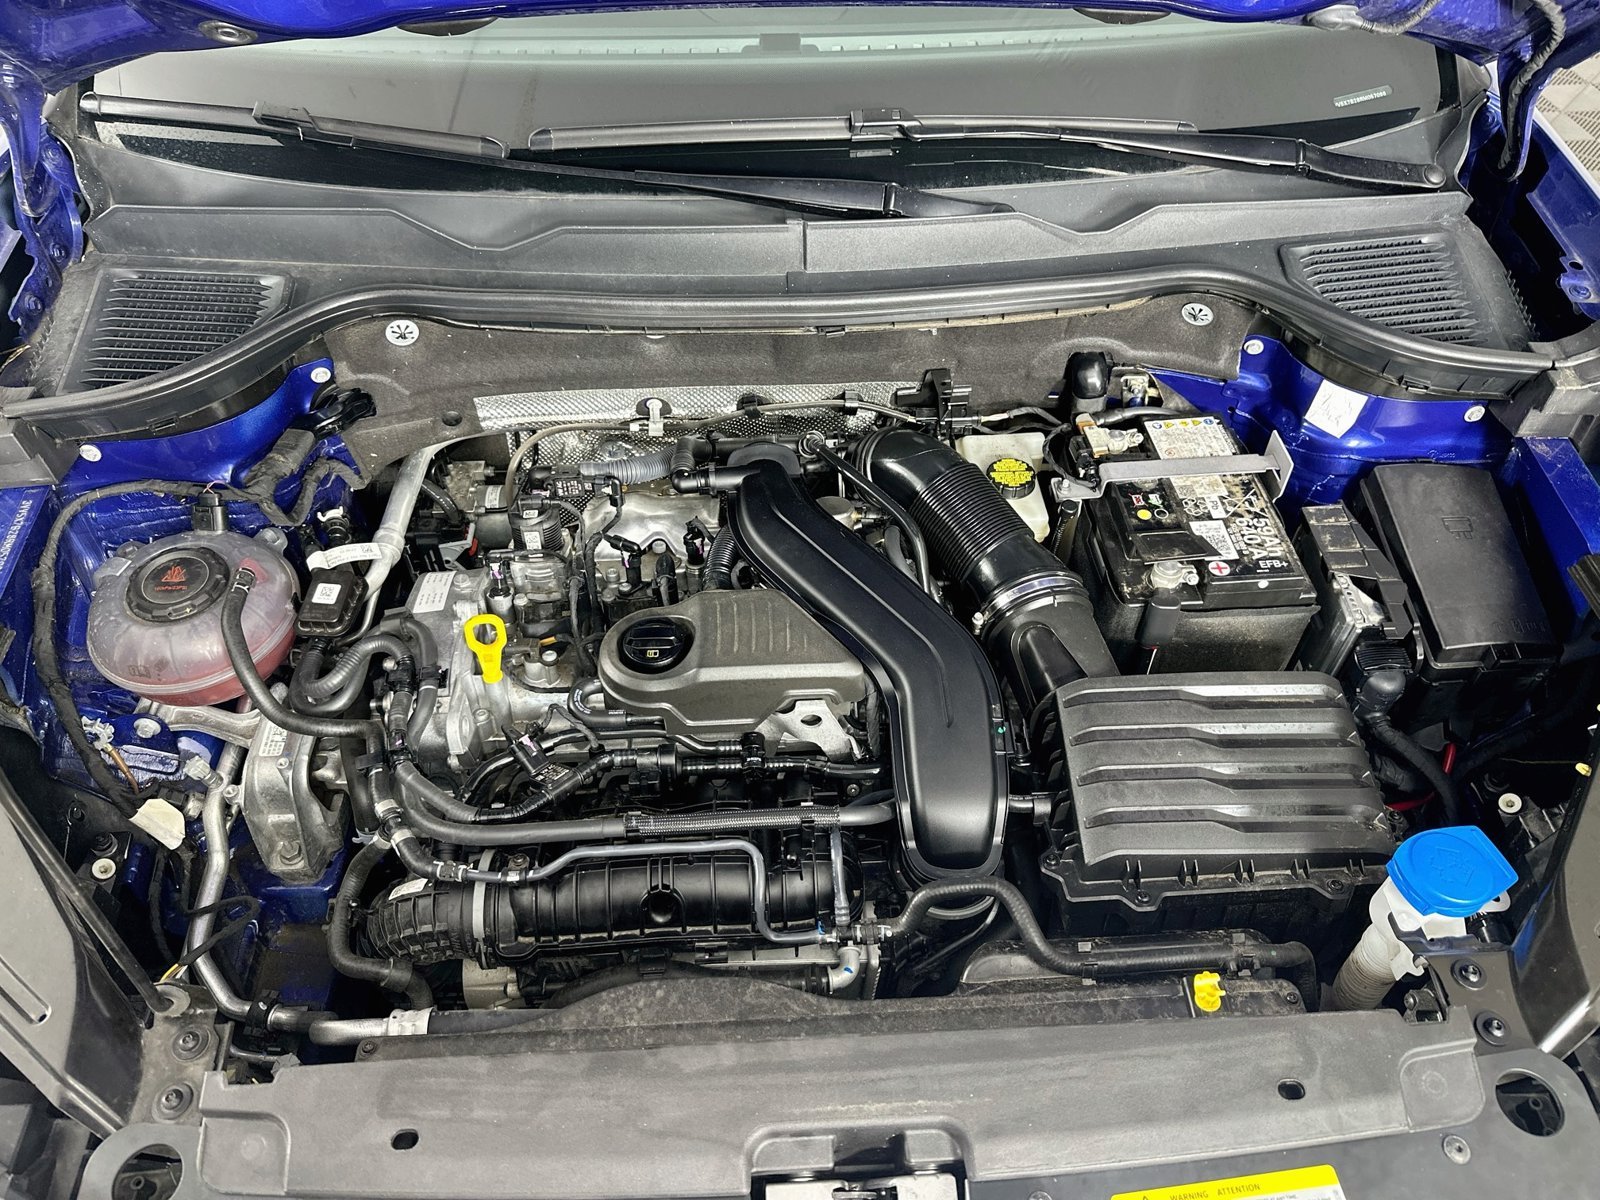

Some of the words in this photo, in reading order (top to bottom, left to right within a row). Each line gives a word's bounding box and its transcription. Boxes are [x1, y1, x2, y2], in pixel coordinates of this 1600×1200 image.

[1235, 517, 1262, 545] 640
[1253, 517, 1283, 557] 59Ah
[1258, 559, 1288, 569] EFB+
[1170, 1191, 1209, 1200] WARNING
[1217, 1184, 1261, 1196] ATTENTION
